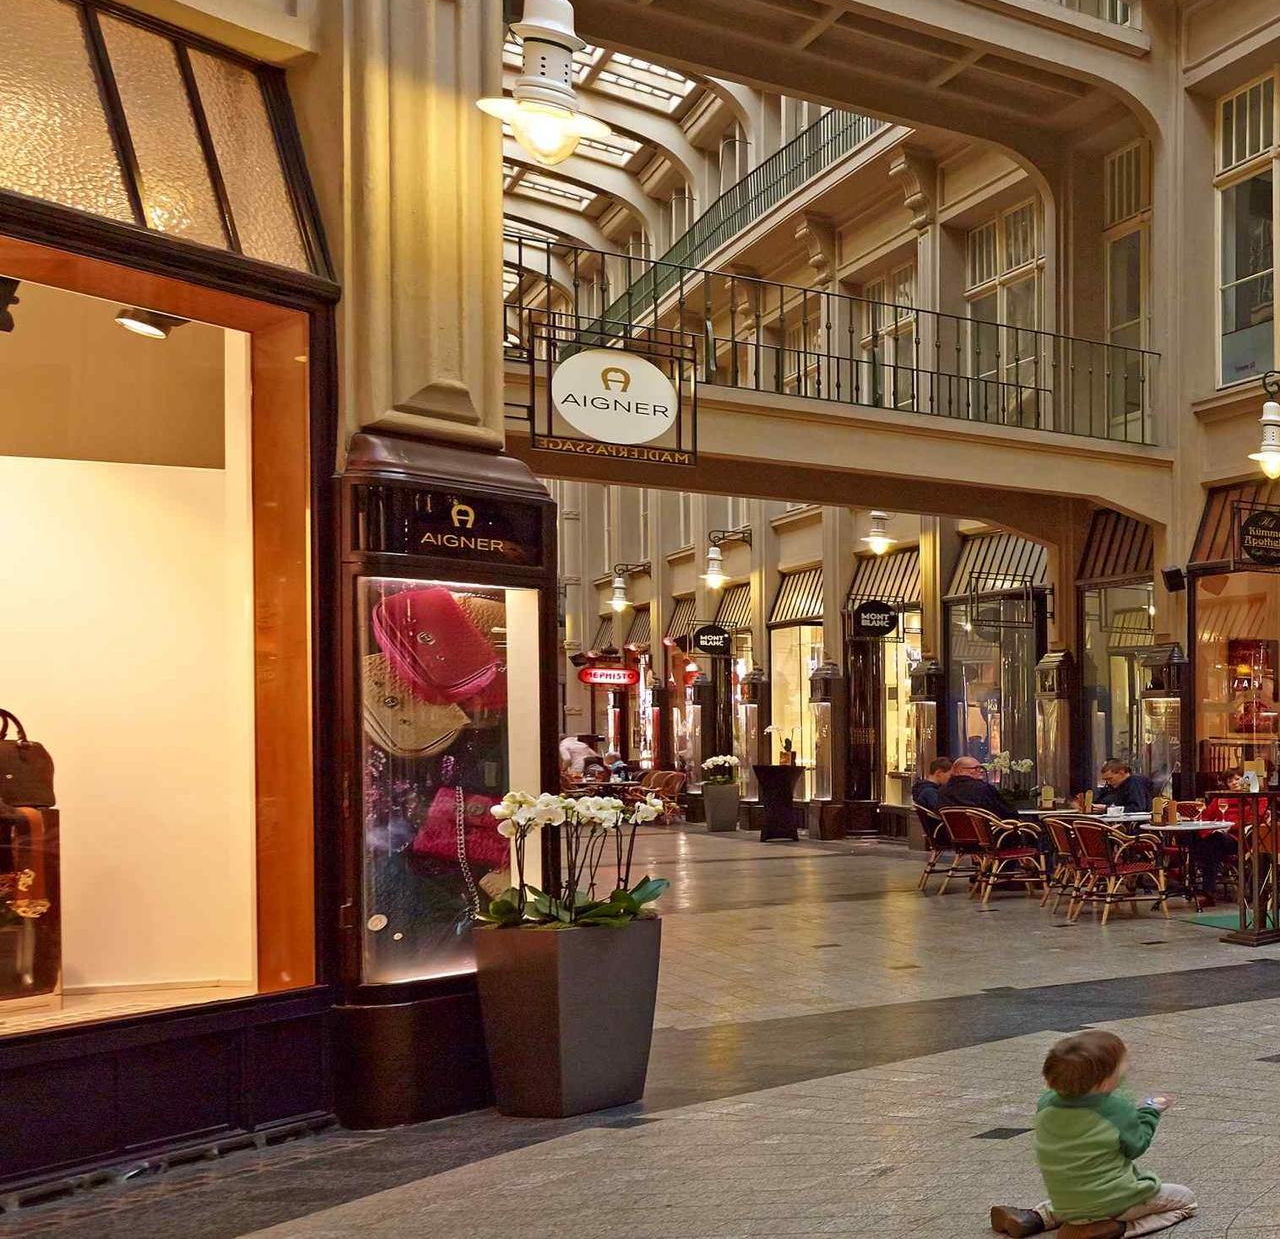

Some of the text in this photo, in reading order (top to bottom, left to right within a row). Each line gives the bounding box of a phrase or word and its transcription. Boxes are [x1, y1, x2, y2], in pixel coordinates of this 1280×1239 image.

[561, 393, 669, 418] AIGNER
[420, 532, 504, 552] AIGNER
[861, 612, 890, 620] MONT
[861, 619, 890, 627] BLANC
[584, 671, 634, 681] MEPHISTO
